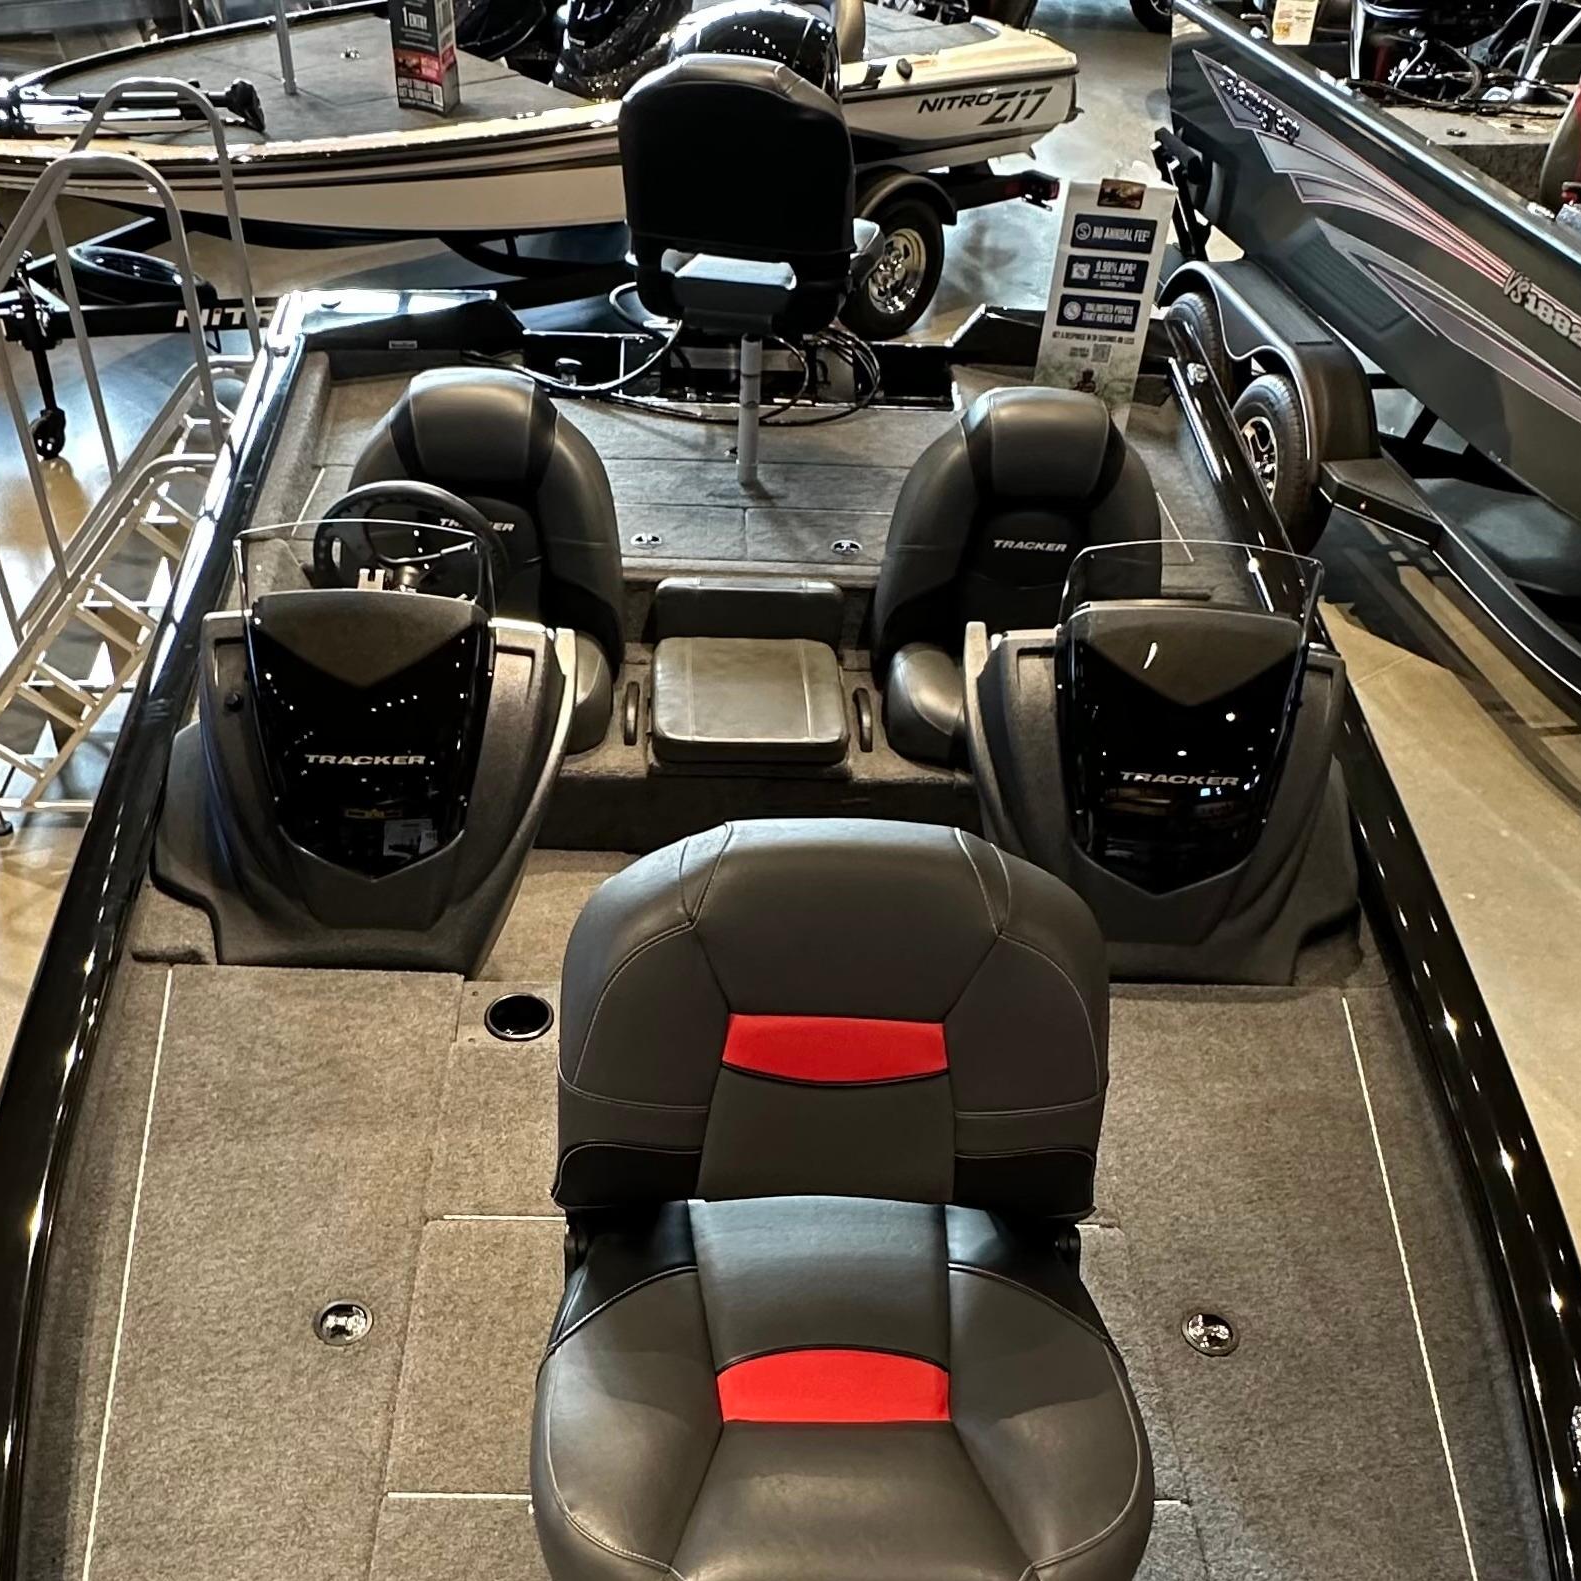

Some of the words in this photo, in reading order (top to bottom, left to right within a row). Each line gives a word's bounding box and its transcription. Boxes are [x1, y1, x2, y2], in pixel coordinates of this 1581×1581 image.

[918, 93, 993, 114] NITRO
[993, 540, 1068, 552] TRACKER
[304, 754, 426, 765] TRACKER
[1120, 771, 1239, 786] TRACKER
